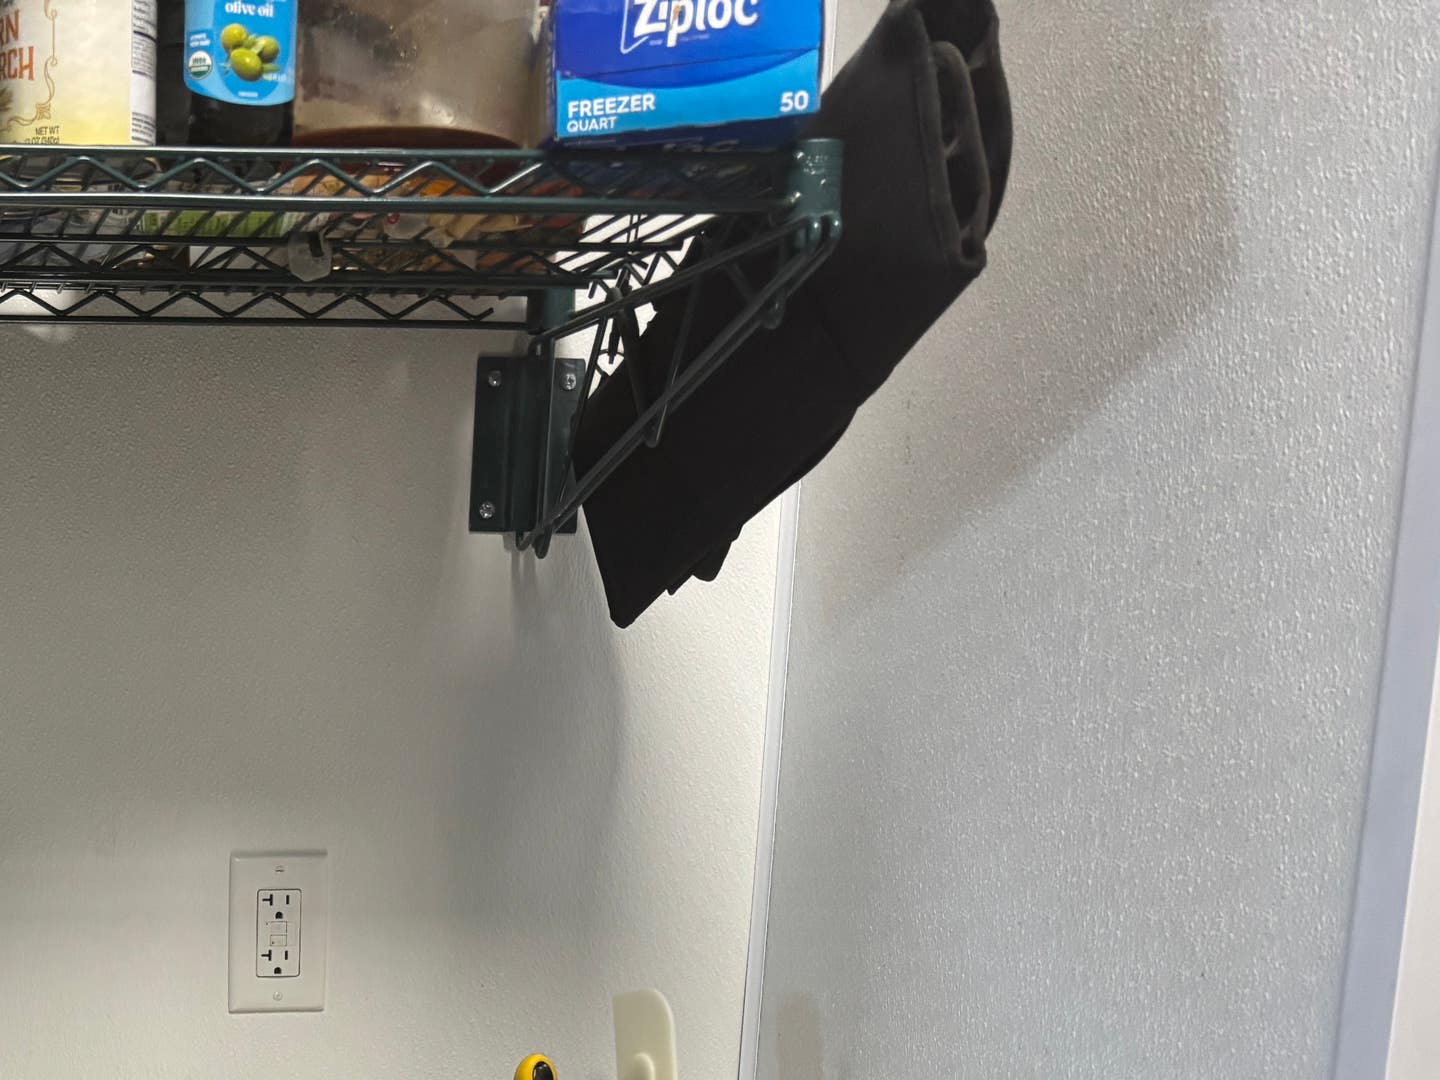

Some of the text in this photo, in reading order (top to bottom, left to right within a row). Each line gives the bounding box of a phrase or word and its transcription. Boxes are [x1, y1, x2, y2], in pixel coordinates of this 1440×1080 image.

[225, 1, 274, 17] olive oil
[567, 93, 656, 119] FREEZER
[780, 91, 809, 112] 50
[35, 125, 60, 136] NET WT
[566, 116, 617, 132] QUART
